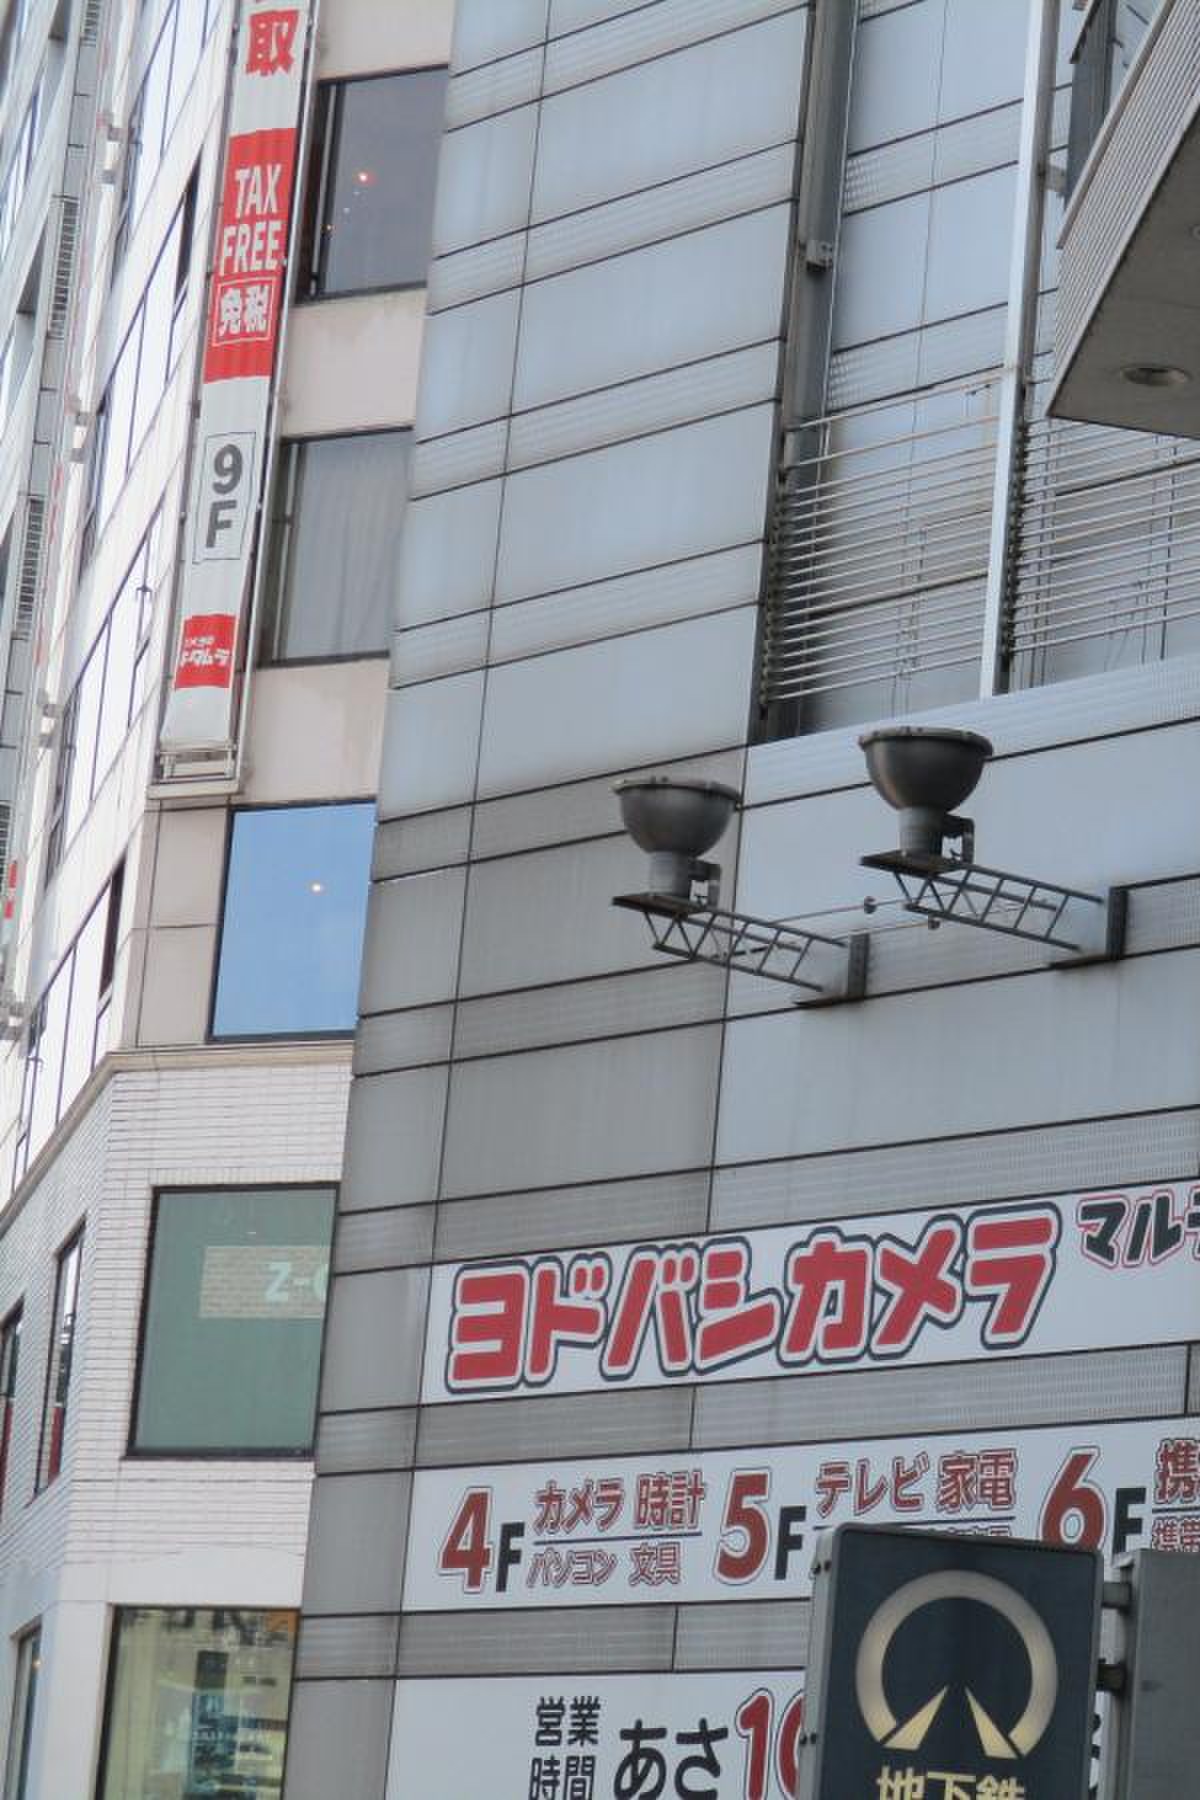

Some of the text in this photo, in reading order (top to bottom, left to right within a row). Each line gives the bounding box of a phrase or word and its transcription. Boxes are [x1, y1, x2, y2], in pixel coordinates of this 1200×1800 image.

[245, 0, 300, 77] 取
[233, 163, 282, 220] TAX
[218, 220, 282, 278] FREE
[217, 284, 270, 336] 免税
[445, 1202, 1060, 1394] ヨドバシカメラ
[438, 1486, 526, 1595] 4F
[533, 1475, 626, 1535] カメラ
[634, 1468, 705, 1532] 時計
[713, 1466, 807, 1585] 5F
[815, 1452, 930, 1518] テレビ
[936, 1447, 1018, 1514] 家電
[526, 1546, 619, 1589] パソコン
[629, 1540, 682, 1587] 文具
[534, 1696, 602, 1747] 営業
[528, 1755, 597, 1800] 時間
